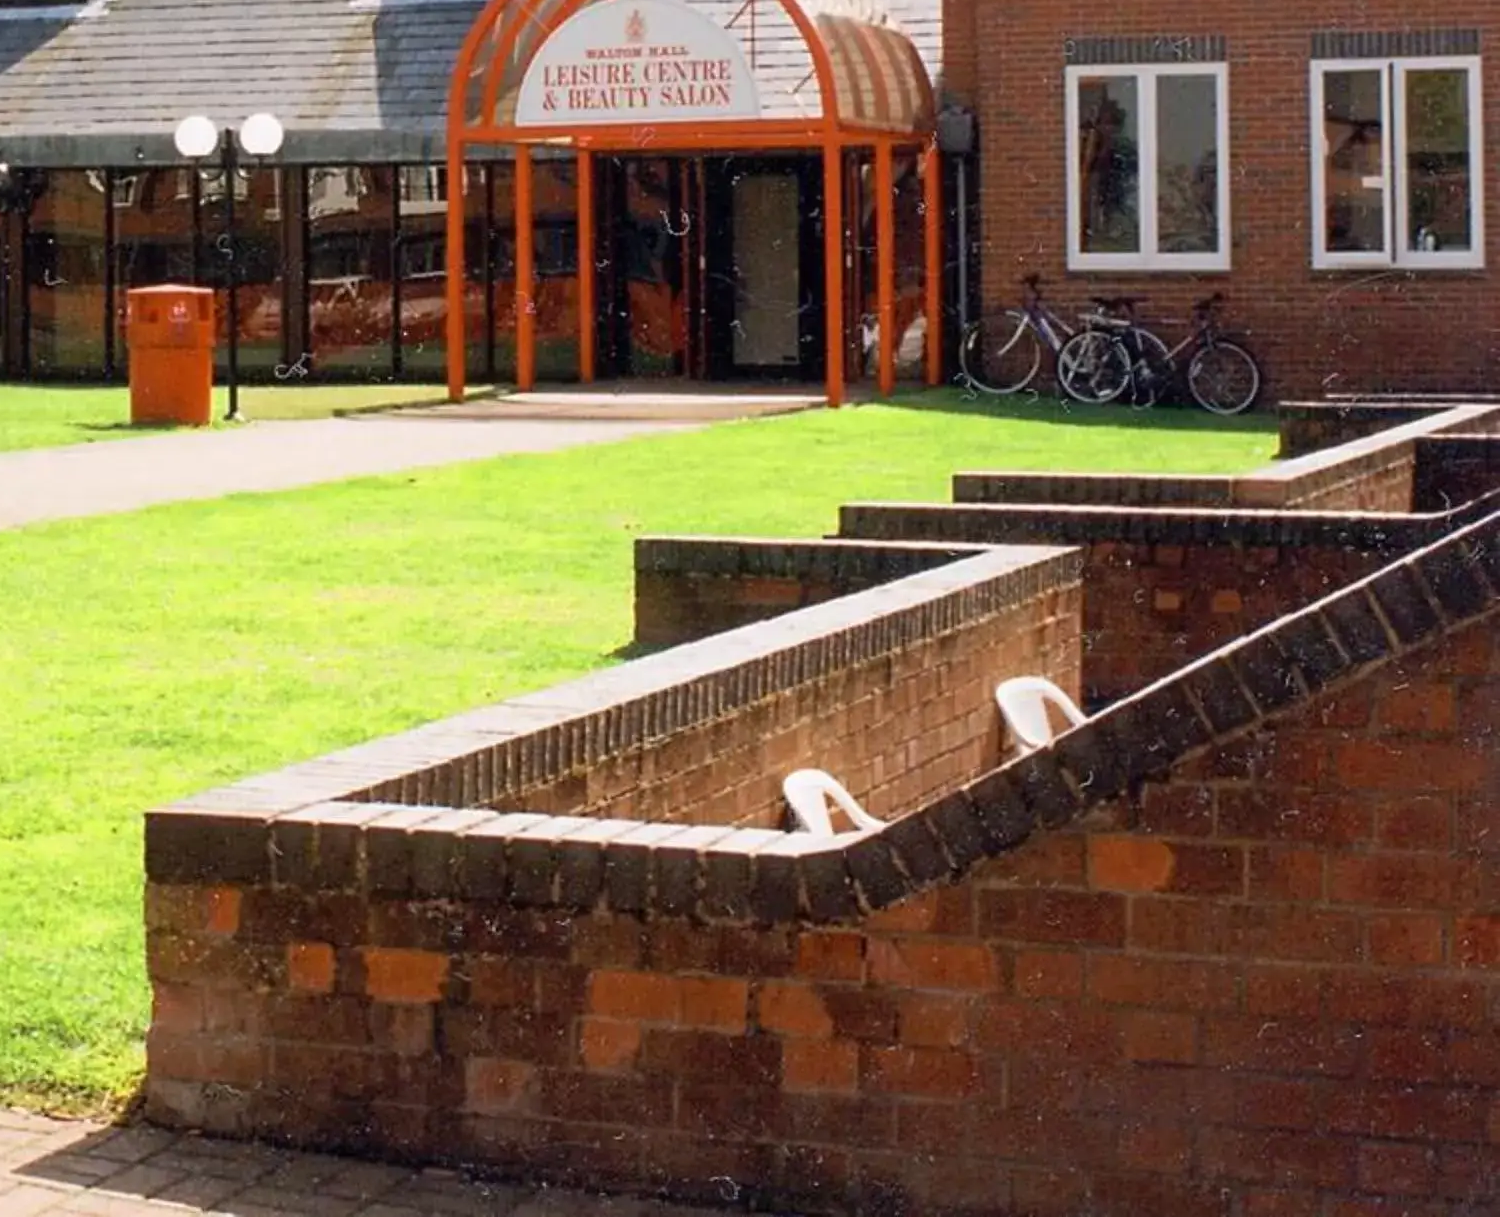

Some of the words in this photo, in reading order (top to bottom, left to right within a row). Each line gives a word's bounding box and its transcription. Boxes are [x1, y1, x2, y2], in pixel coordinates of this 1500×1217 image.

[649, 46, 689, 56] HALL
[544, 63, 635, 87] LEISURE
[643, 59, 732, 83] CENTRE
[542, 89, 559, 111] &
[568, 86, 652, 110] BEAUTY
[660, 84, 731, 107] SALON
